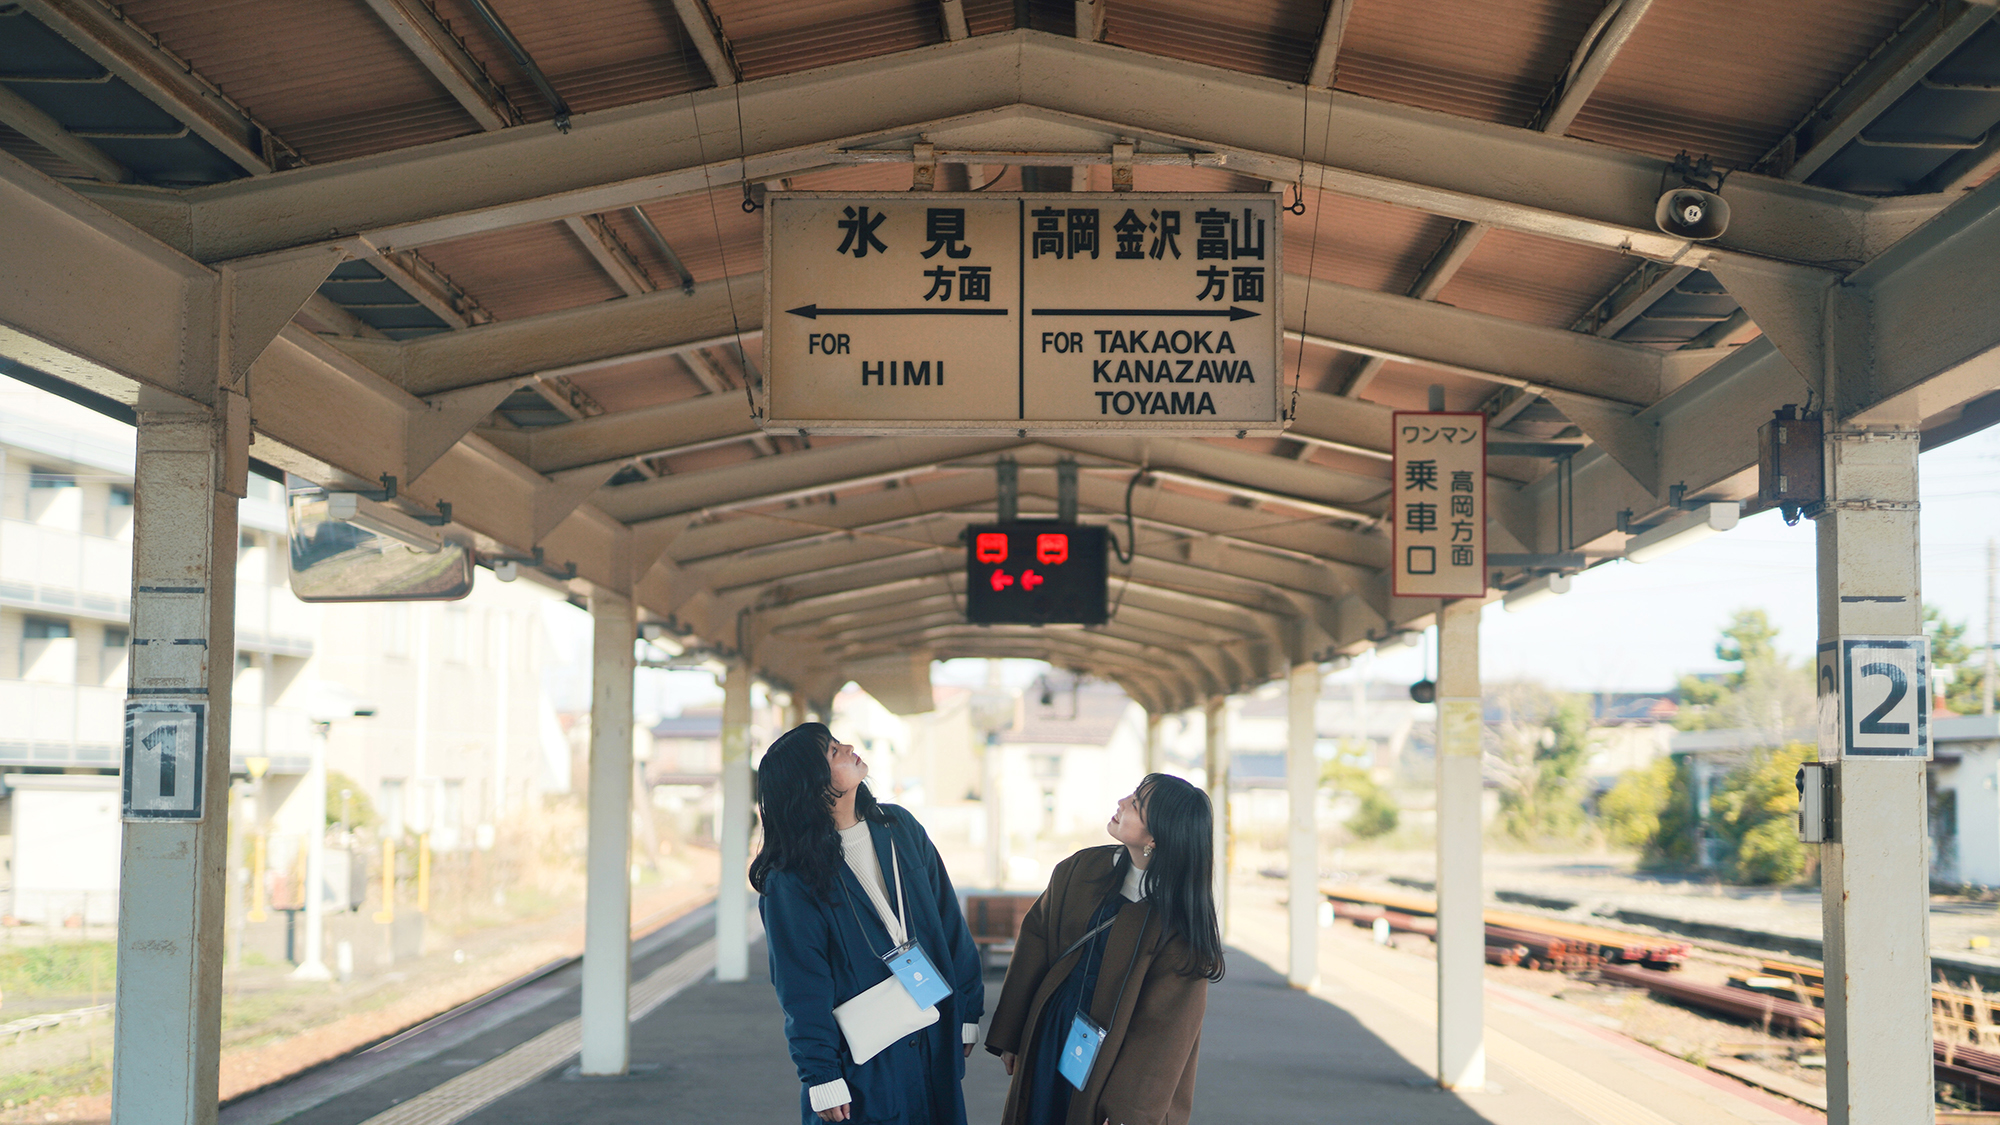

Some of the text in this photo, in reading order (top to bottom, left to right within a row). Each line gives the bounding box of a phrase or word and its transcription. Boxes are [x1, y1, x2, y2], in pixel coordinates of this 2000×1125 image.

[1030, 205, 1266, 261] 高岡 金沢 富山
[922, 264, 992, 302] 方面
[1195, 264, 1265, 303] 方面
[808, 332, 851, 355] FOR
[1041, 329, 1236, 355] FOR TAKAOKA
[861, 360, 944, 386] HIMI
[1093, 359, 1256, 384] KANAZAWA
[1094, 390, 1217, 416] TOYAMA
[1402, 426, 1478, 445] ワンマン
[1405, 459, 1438, 575] 乗車口
[1450, 470, 1475, 566] 高岡方面
[1859, 662, 1910, 735] 2
[141, 725, 177, 797] 1
